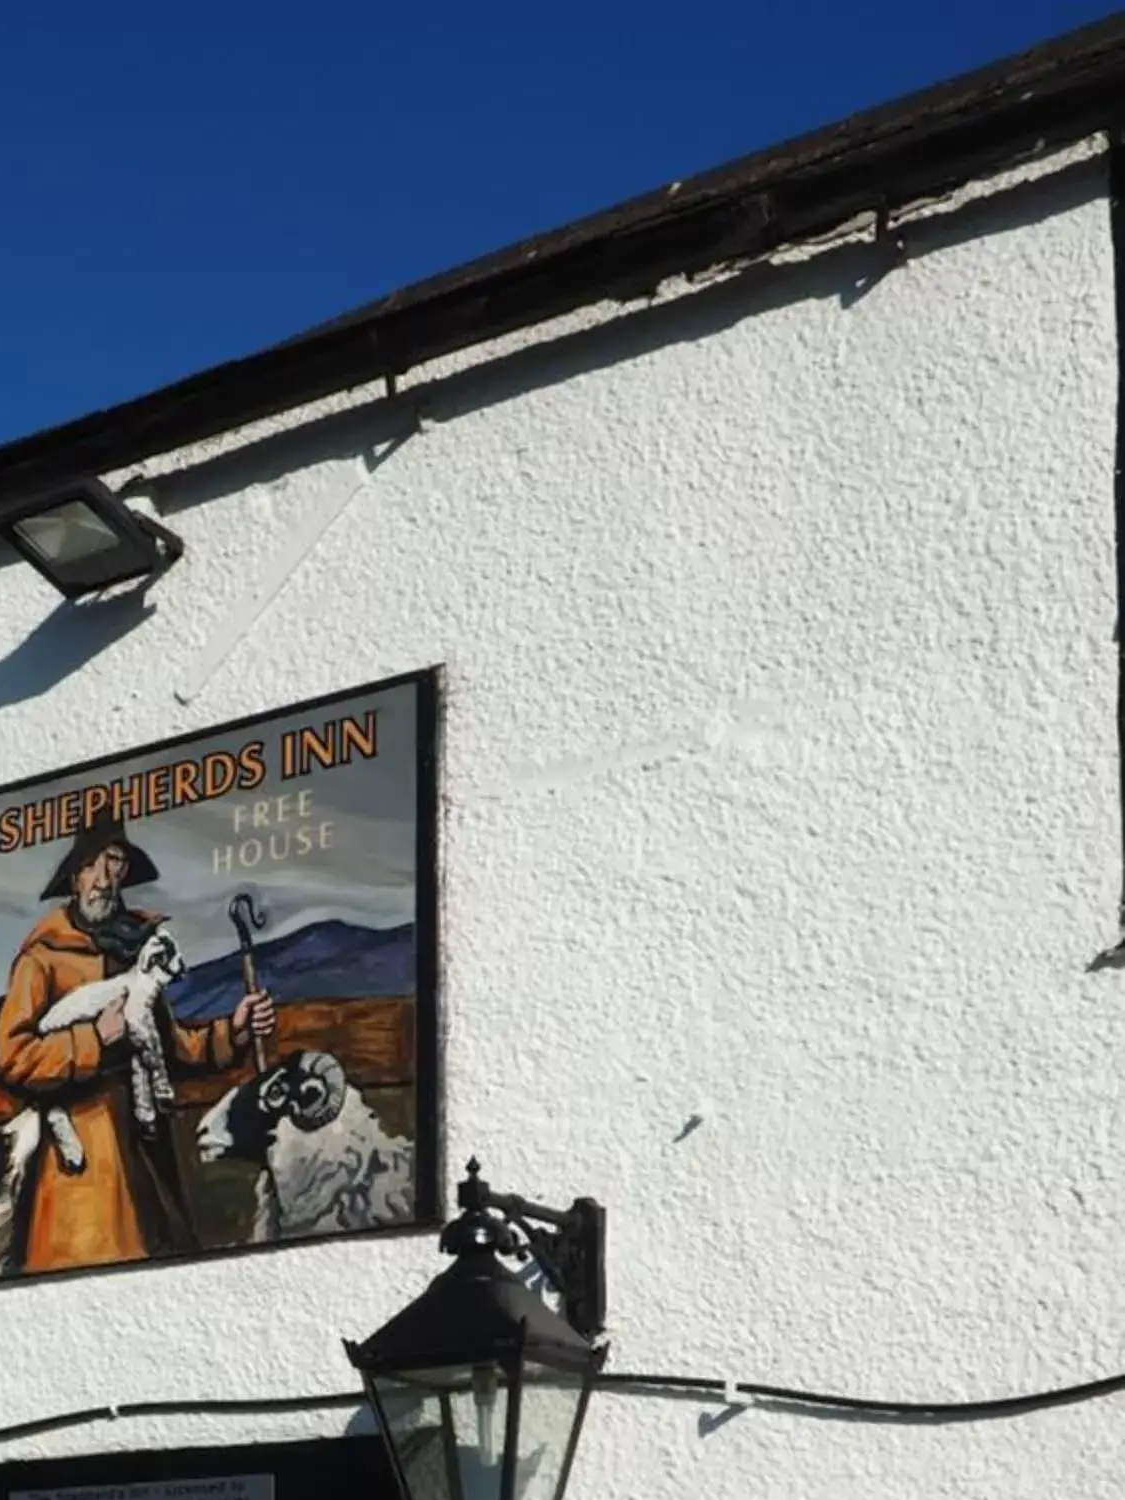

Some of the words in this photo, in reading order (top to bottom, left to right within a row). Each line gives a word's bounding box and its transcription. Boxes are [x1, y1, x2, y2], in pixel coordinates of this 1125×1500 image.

[281, 708, 378, 781] INN
[233, 788, 313, 833] FREE
[213, 820, 334, 875] HOUSE
